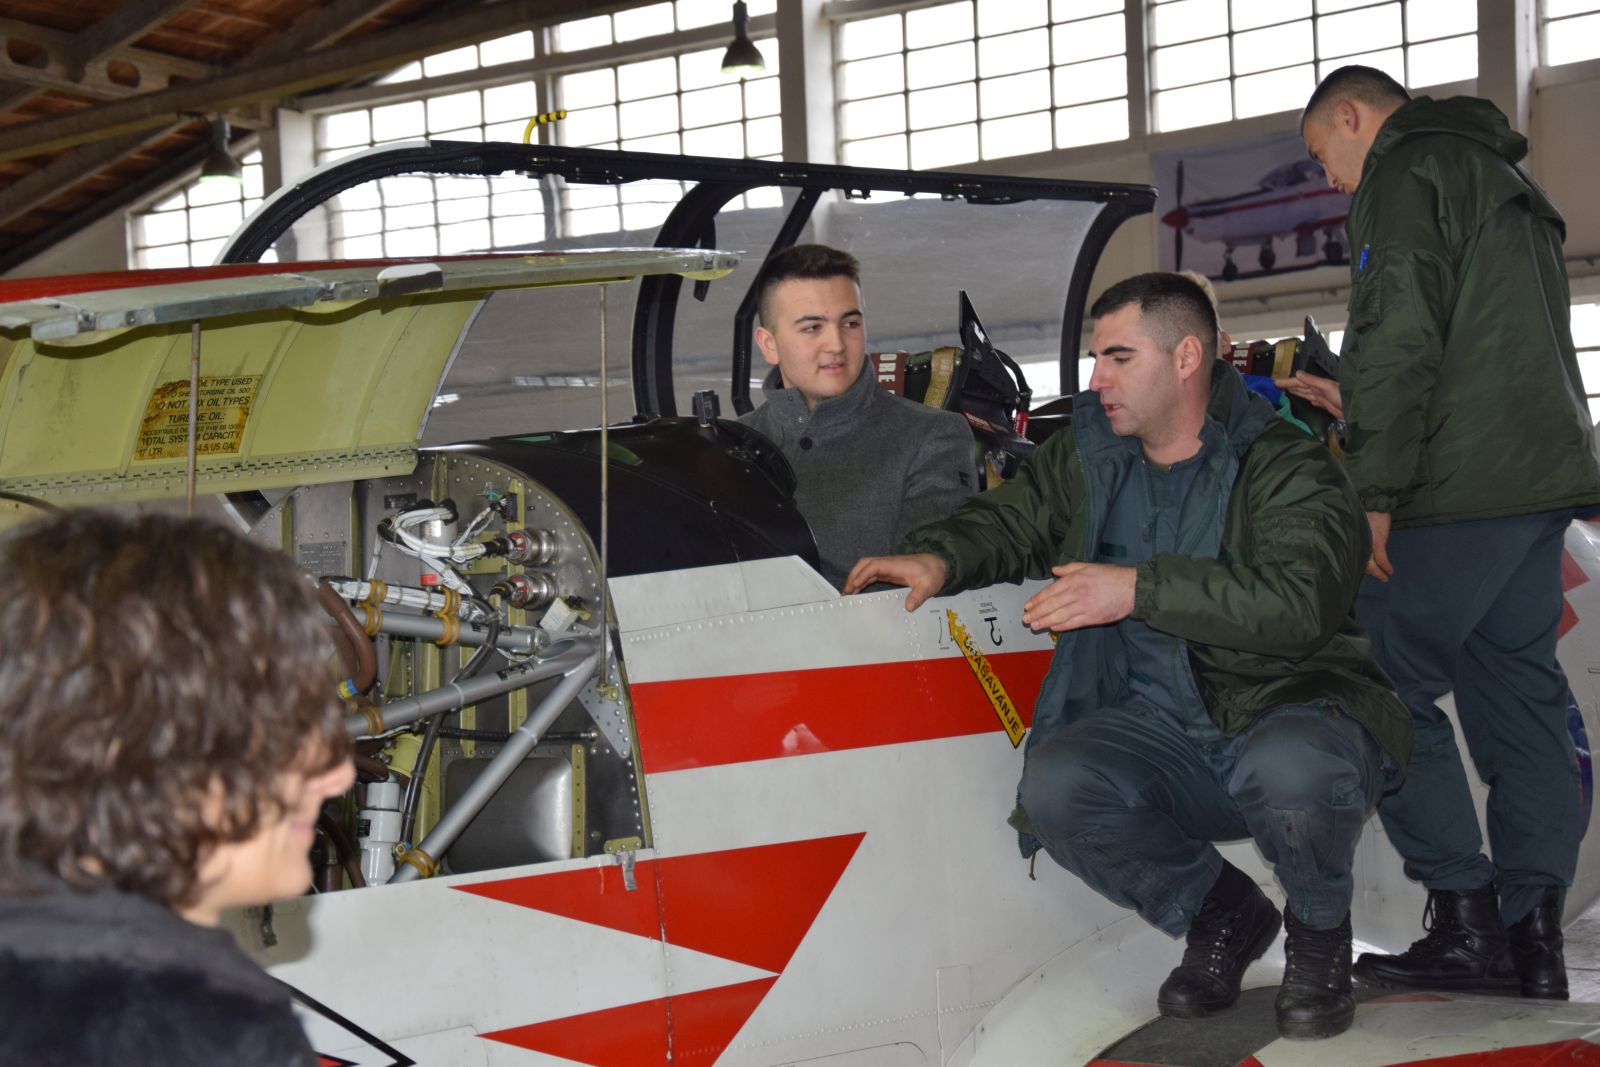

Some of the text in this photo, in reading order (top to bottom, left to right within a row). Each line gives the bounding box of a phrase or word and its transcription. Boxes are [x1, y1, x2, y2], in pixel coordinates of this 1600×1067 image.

[211, 378, 231, 387] TYPE
[232, 377, 253, 386] USED
[200, 388, 226, 396] TURBINE
[167, 399, 188, 410] NOT
[207, 398, 220, 408] OIL
[223, 396, 251, 406] TYPES
[168, 412, 209, 424] TURBNE
[142, 430, 241, 446] TOTAL SYST CAPACITY
[148, 447, 163, 457] LTR
[211, 442, 221, 452] US
[222, 441, 237, 450] GAL
